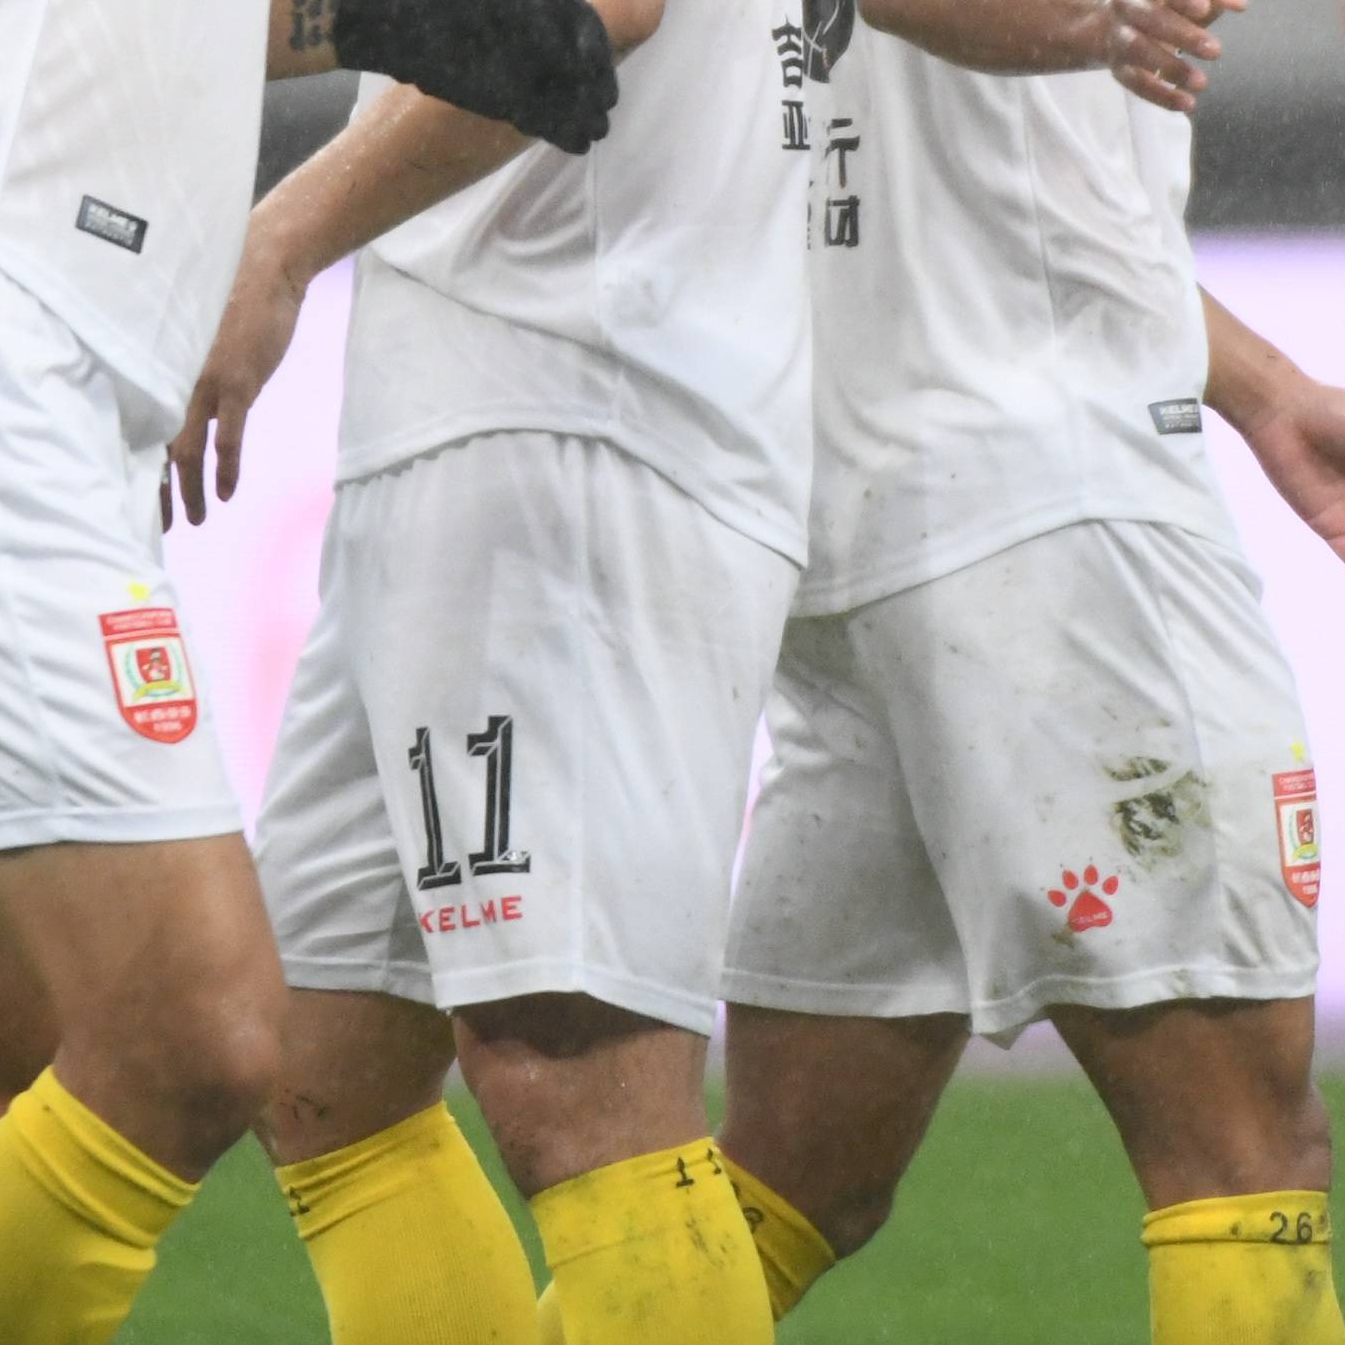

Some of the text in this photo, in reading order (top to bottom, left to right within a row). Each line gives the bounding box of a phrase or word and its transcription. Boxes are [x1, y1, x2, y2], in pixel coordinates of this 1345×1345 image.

[408, 715, 532, 892] 11
[419, 895, 524, 935] KELME
[1269, 1210, 1313, 1246] 26
